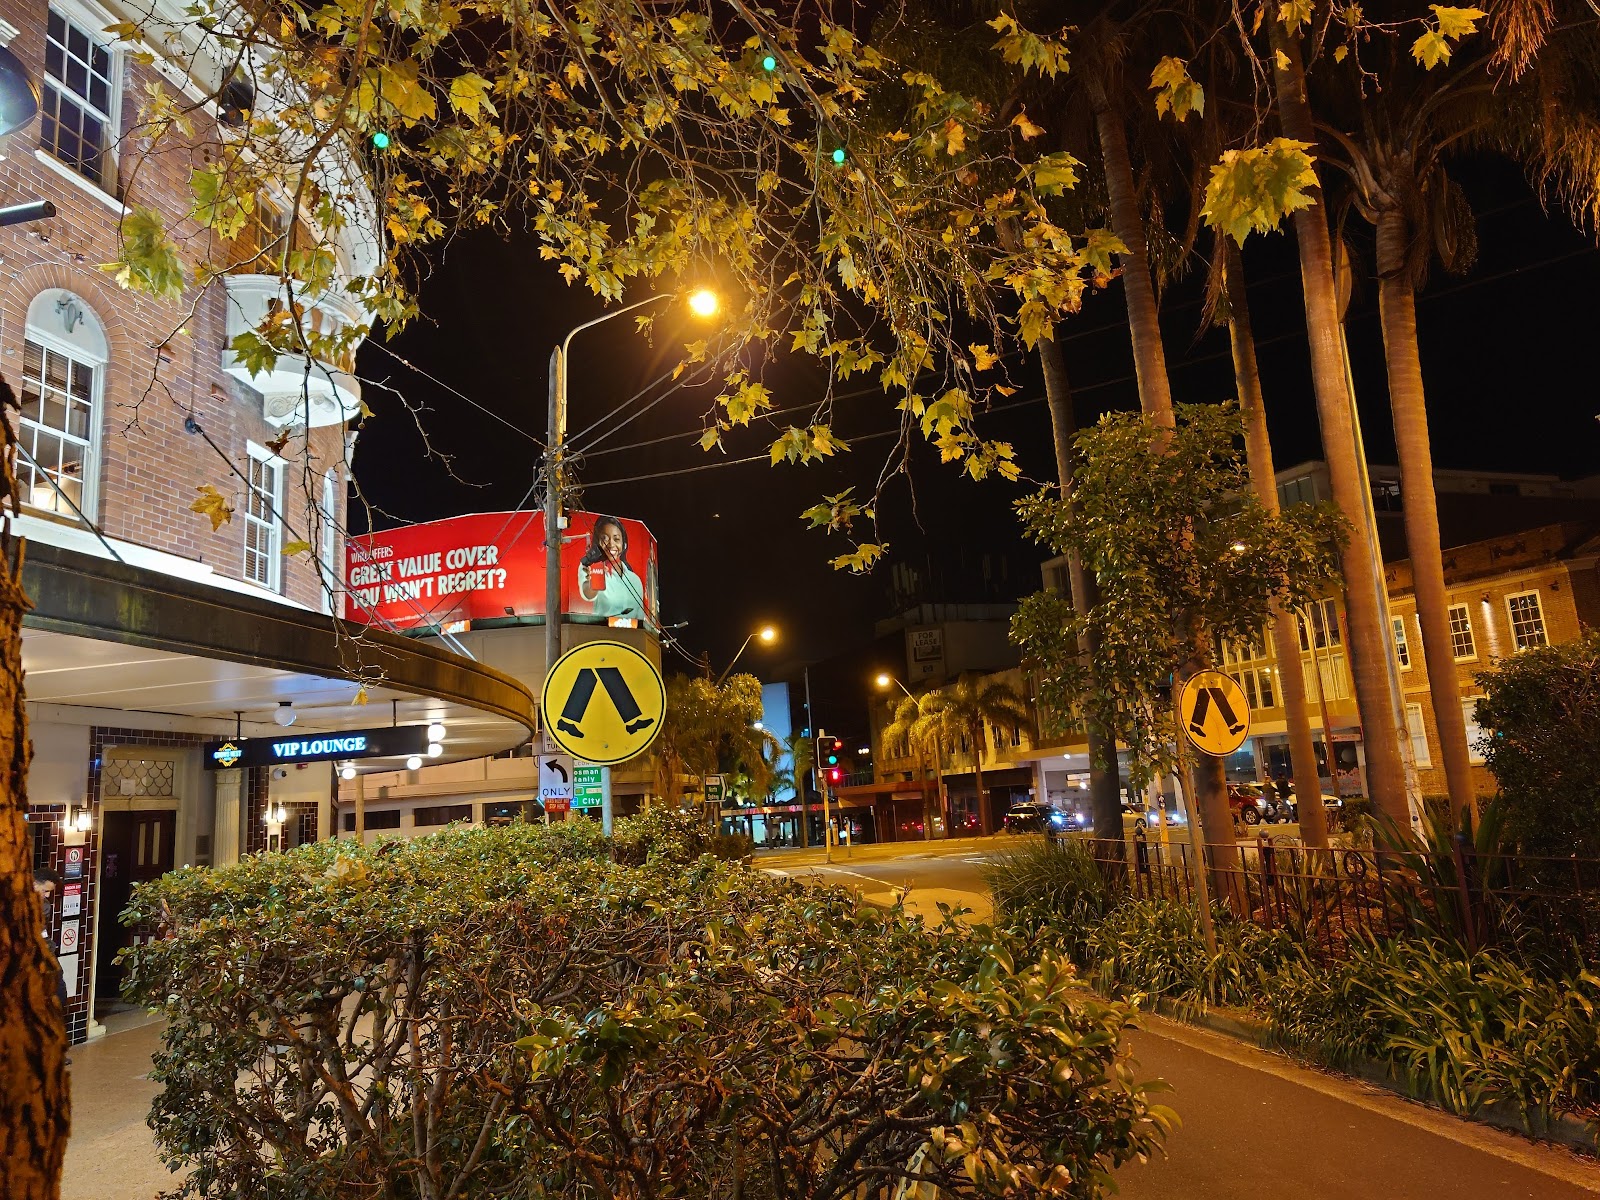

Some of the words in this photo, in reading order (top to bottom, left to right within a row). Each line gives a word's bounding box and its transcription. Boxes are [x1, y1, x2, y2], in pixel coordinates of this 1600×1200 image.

[350, 560, 394, 587] GREAT
[397, 552, 442, 578] VALUE
[445, 545, 499, 570] COVER
[351, 586, 380, 610] YOU
[383, 577, 434, 604] WON'T
[438, 568, 507, 596] REGRET?
[918, 631, 934, 639] FOR
[273, 742, 298, 757] VIP
[301, 737, 366, 755] LOUNGE
[542, 787, 571, 797] ONLY
[582, 797, 601, 805] City
